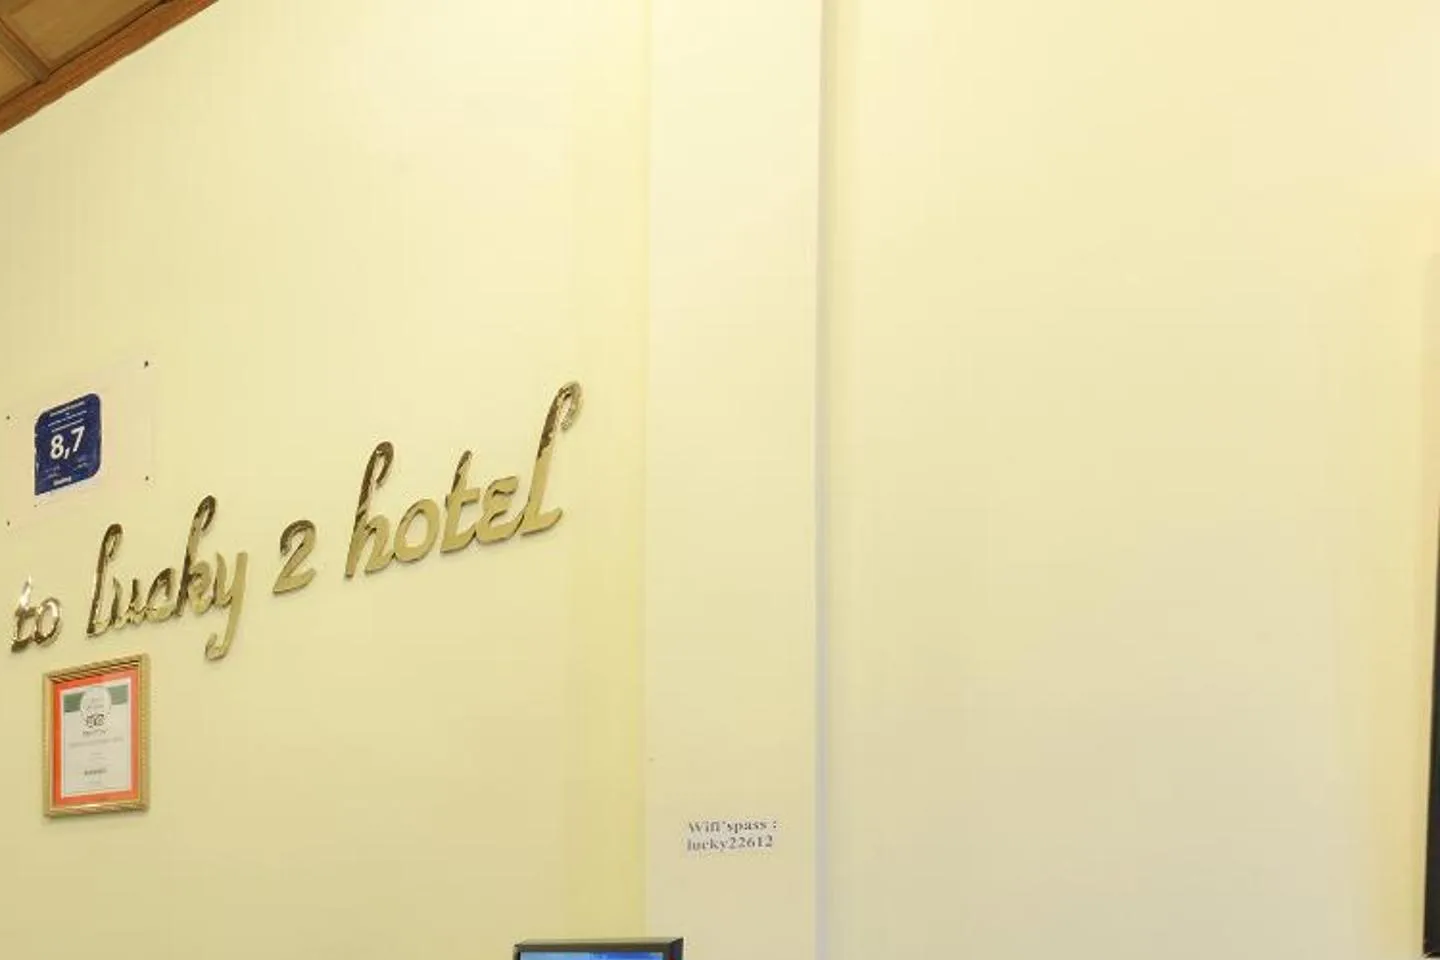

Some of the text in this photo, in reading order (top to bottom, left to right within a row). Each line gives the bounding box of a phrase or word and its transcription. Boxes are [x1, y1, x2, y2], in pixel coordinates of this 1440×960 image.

[50, 425, 85, 460] 8,7
[11, 575, 62, 653] to
[272, 519, 317, 594] 2
[345, 381, 583, 580] hotel
[687, 835, 773, 852] lucky22612
